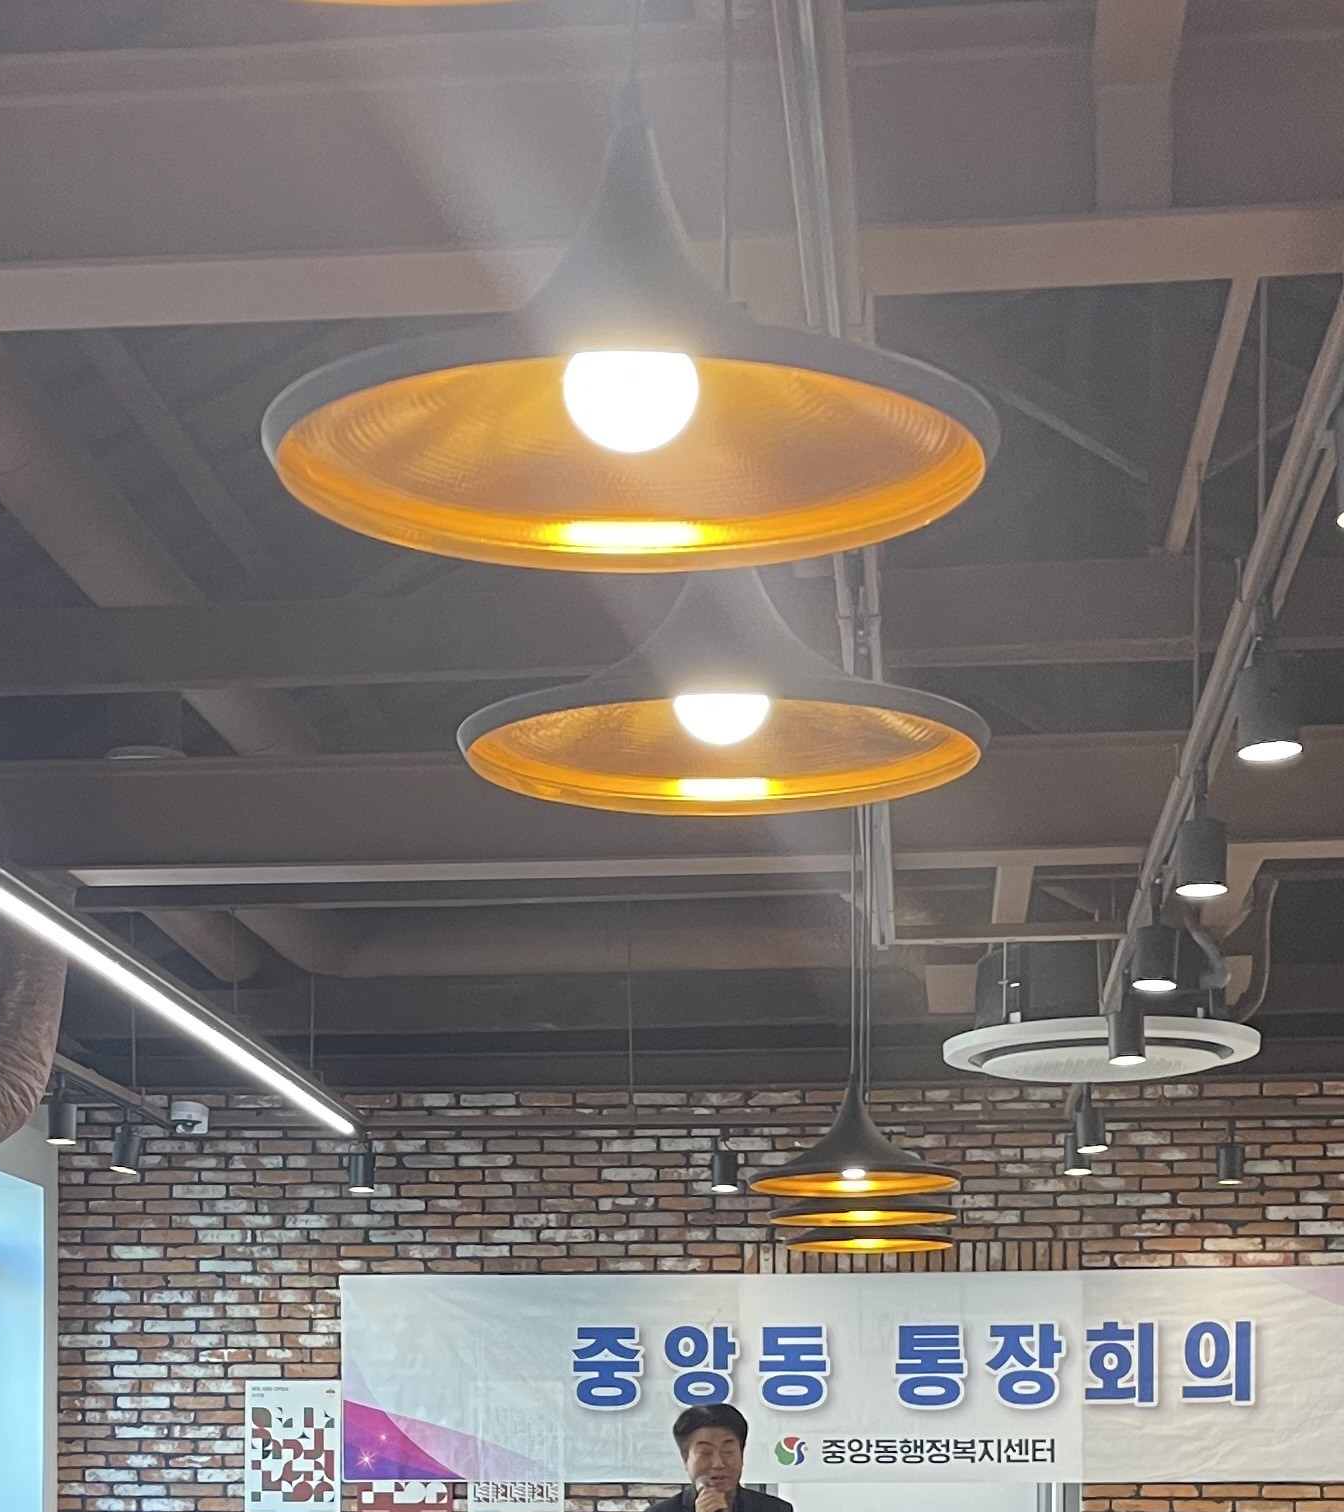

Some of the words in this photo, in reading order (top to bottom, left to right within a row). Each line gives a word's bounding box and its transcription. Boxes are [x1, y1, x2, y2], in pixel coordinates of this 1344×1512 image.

[570, 1323, 829, 1408] 중앙동
[893, 1320, 1256, 1408] 통장회의
[821, 1437, 1056, 1465] 중앙동행정복지센터
